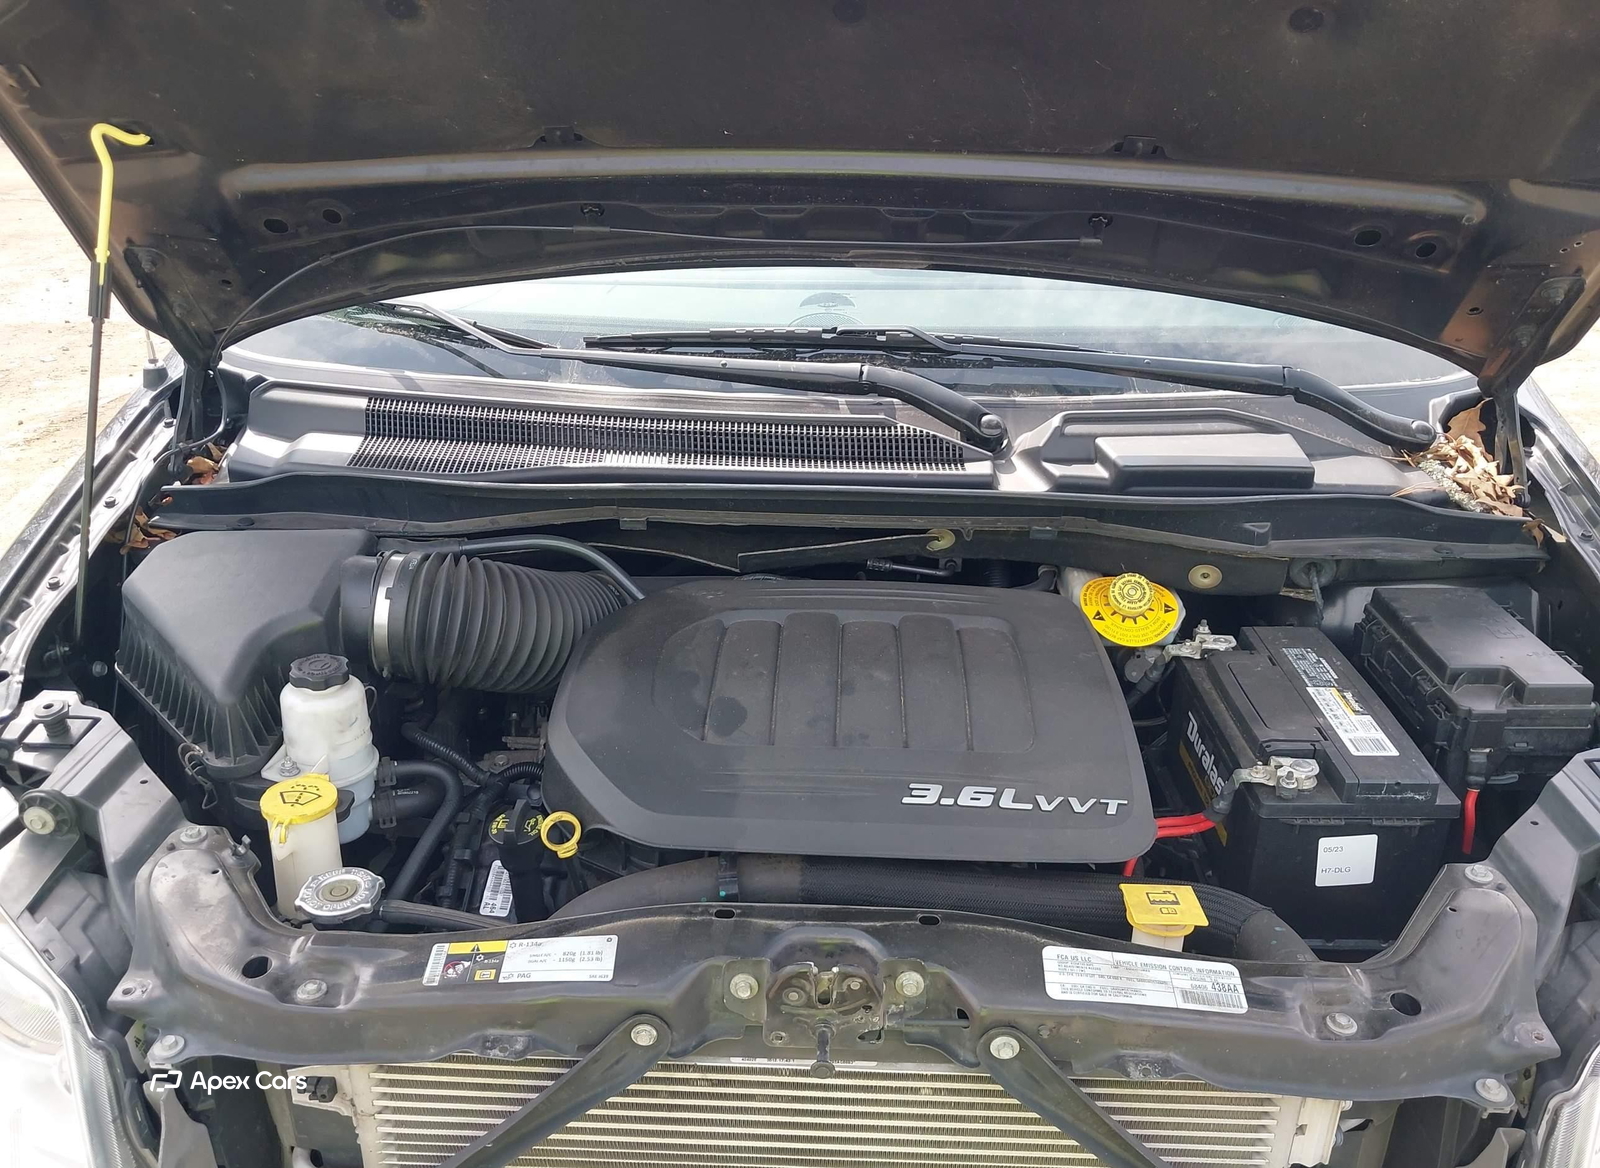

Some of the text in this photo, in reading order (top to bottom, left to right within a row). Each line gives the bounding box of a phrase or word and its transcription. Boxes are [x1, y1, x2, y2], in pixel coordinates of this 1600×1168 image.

[1187, 710, 1228, 796] Duralas
[901, 783, 1128, 815] 3.6L VVT
[1321, 866, 1351, 874] H7-DLG
[1115, 959, 1138, 968] VEHICLE
[1139, 962, 1167, 970] EMISSION
[1168, 965, 1195, 973] CONTROL
[1195, 968, 1236, 977] INFORMATION
[1211, 982, 1240, 994] 438AA
